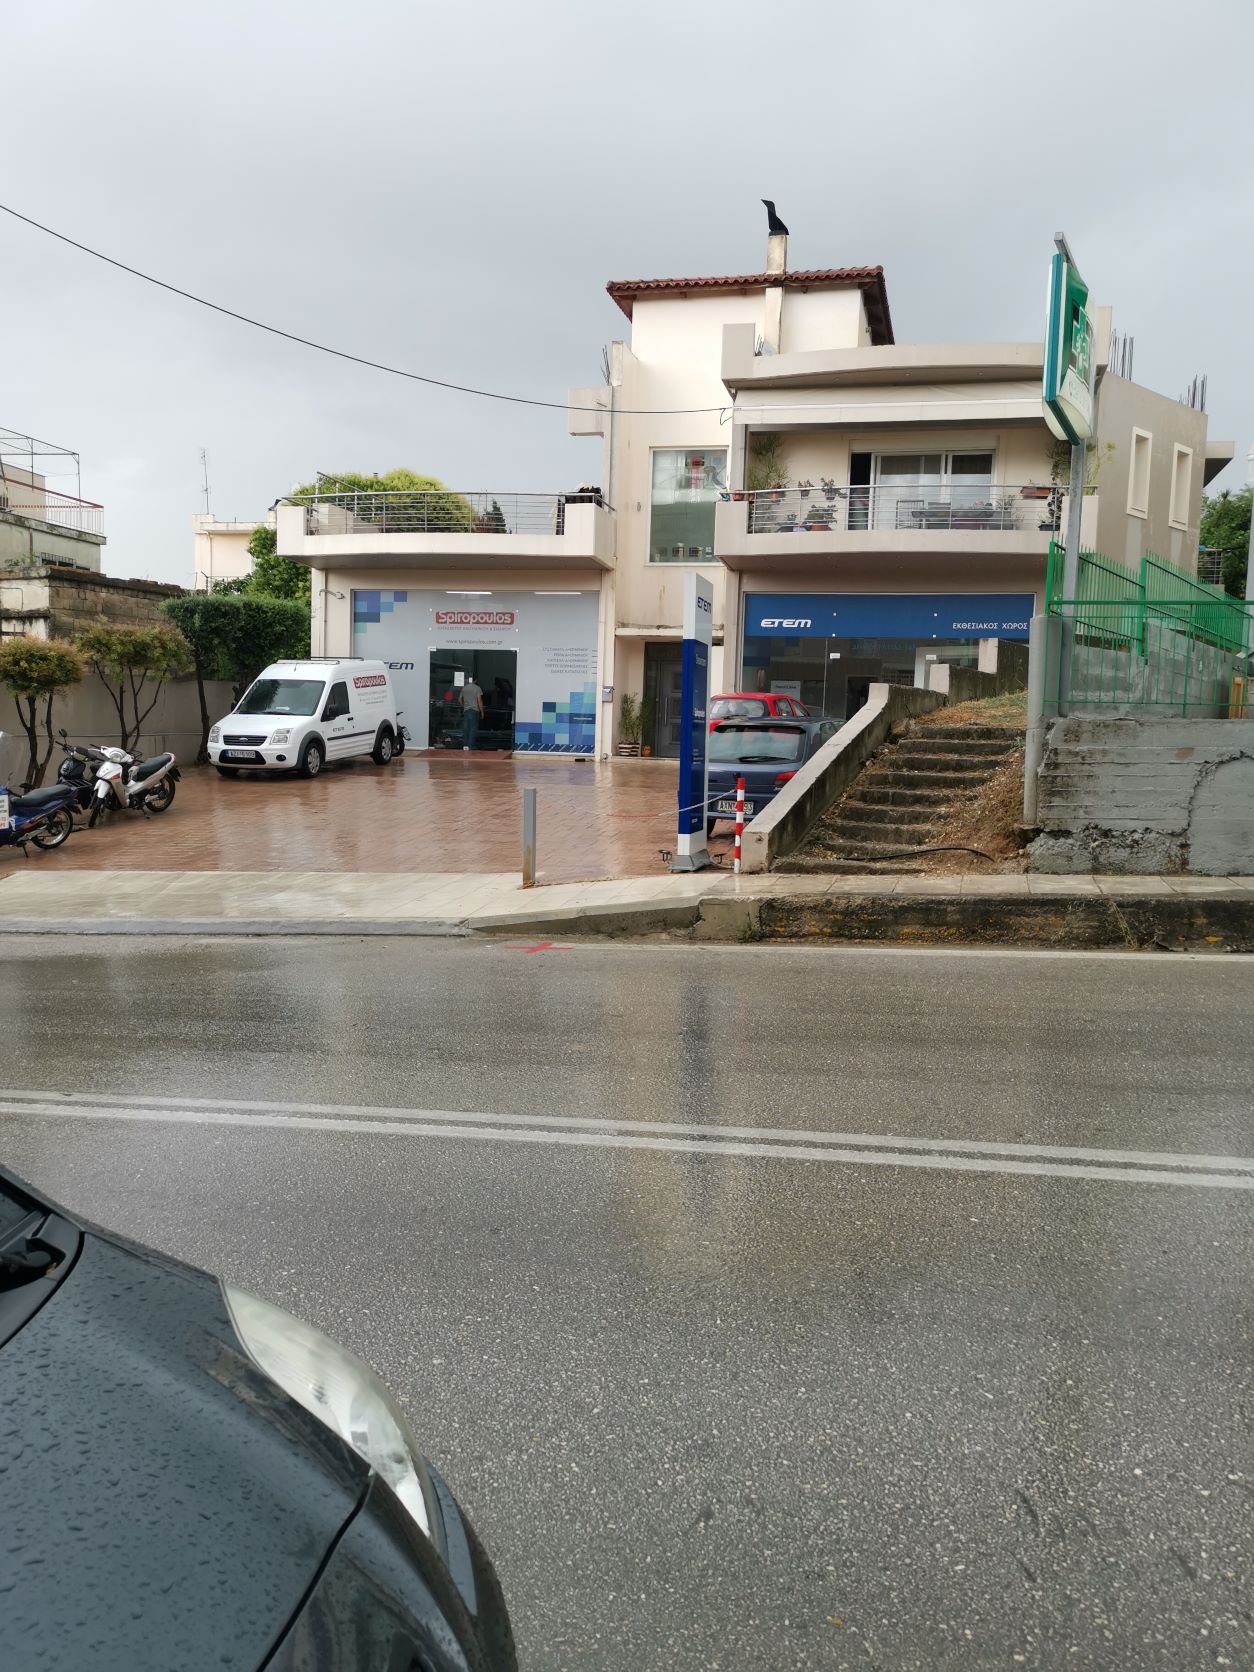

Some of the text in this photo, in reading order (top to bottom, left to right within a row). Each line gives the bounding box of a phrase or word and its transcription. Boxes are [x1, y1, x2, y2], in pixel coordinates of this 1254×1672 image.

[438, 611, 512, 624] Spiropoulos
[760, 618, 811, 628] ETEM
[952, 622, 1028, 630] ΕΚΘΕΣΙΑΚΟΣ ΧΩΡΟΣ
[383, 661, 415, 670] EM
